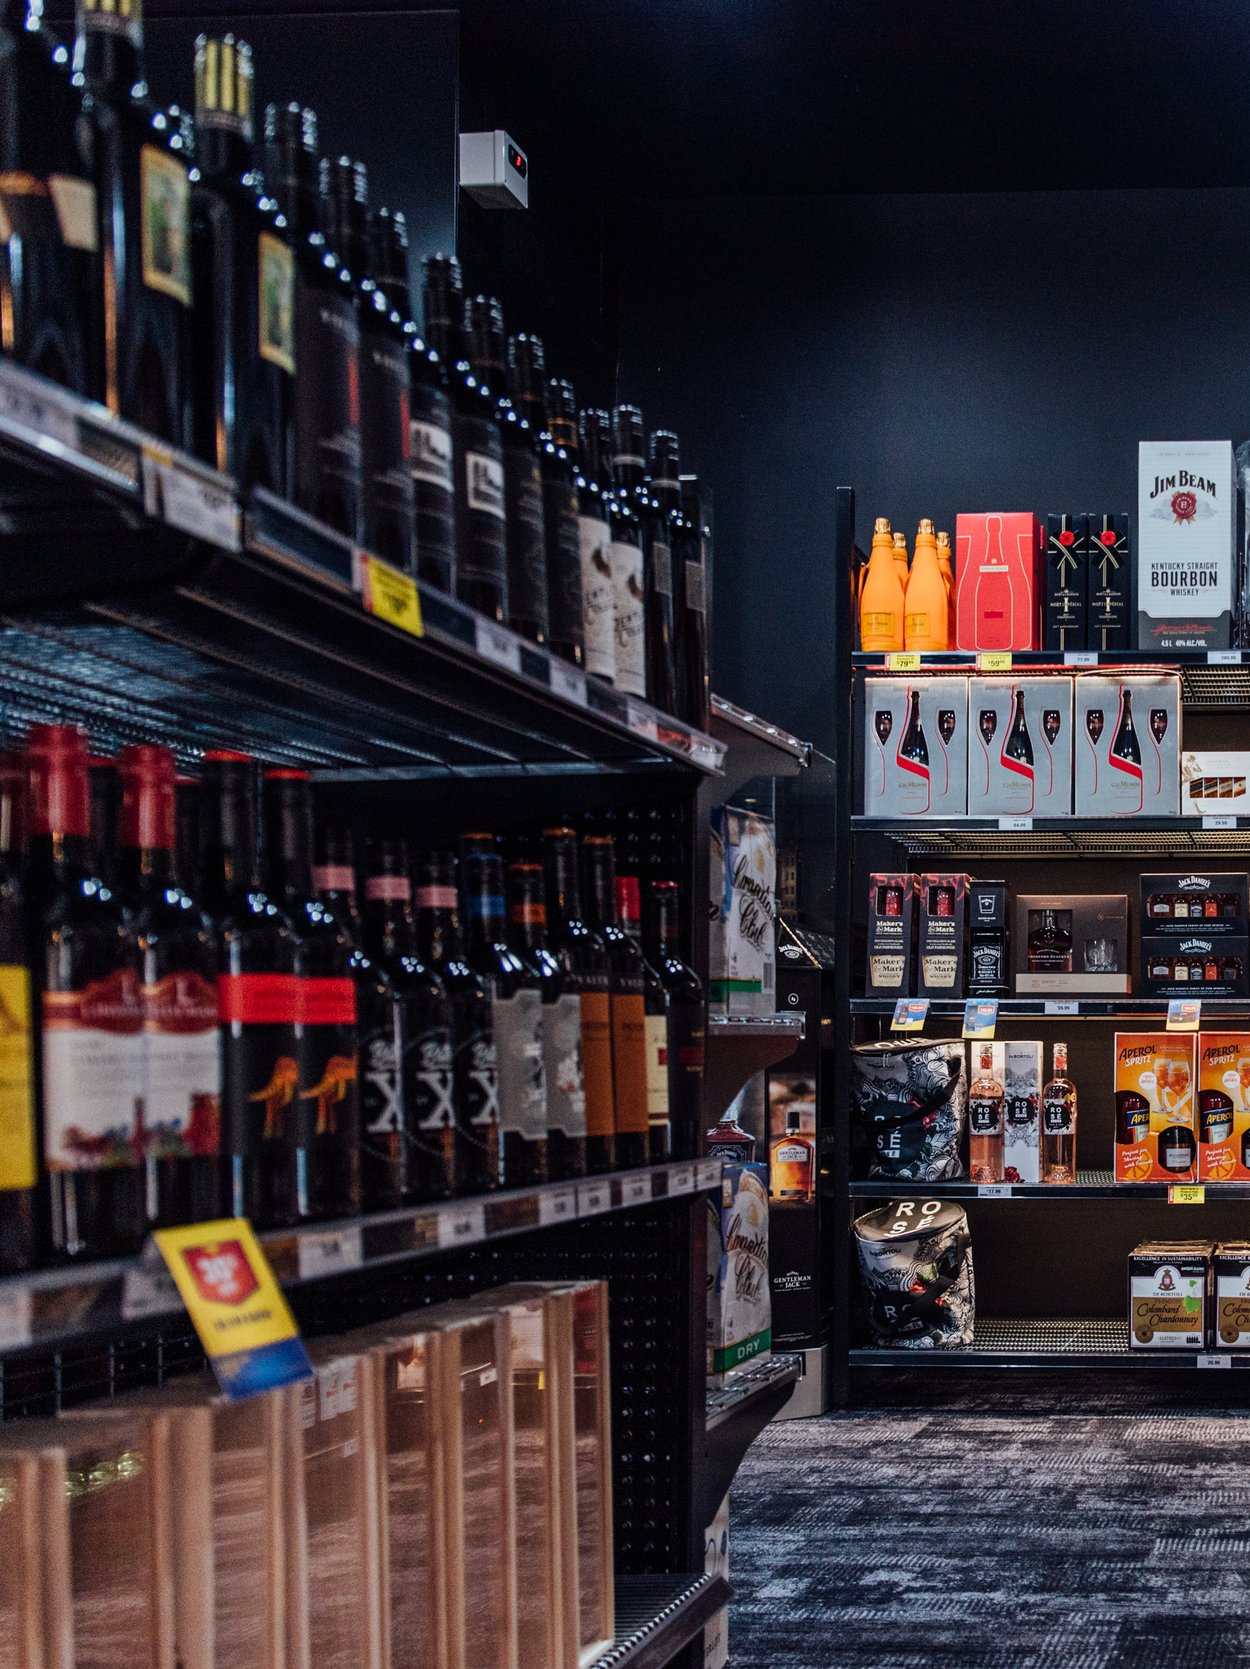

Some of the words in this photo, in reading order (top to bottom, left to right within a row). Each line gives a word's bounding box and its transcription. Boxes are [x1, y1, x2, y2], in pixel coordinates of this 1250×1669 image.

[1150, 474, 1176, 499] JIM
[1178, 470, 1217, 498] BEAM
[1151, 562, 1185, 571] KENTUCKY
[1187, 562, 1218, 570] STRAIGHT
[1151, 571, 1218, 587] BOURBON
[1170, 588, 1200, 596] WHISKEY
[1178, 877, 1191, 889] JACK
[1190, 876, 1211, 888] DANIEL'S
[1179, 940, 1192, 952] JACK
[1192, 938, 1213, 951] DANIEL'S
[1119, 1045, 1157, 1061] APEROL
[1202, 1044, 1240, 1060] APEROL
[1125, 1054, 1152, 1067] SPRITZ
[1209, 1054, 1235, 1066] SPRITZ
[773, 1274, 812, 1284] GENTLEMAN
[785, 1281, 800, 1289] JACK
[1137, 1303, 1180, 1316] Colombard
[1150, 1314, 1199, 1327] Chardonnay
[737, 1338, 761, 1360] DRY
